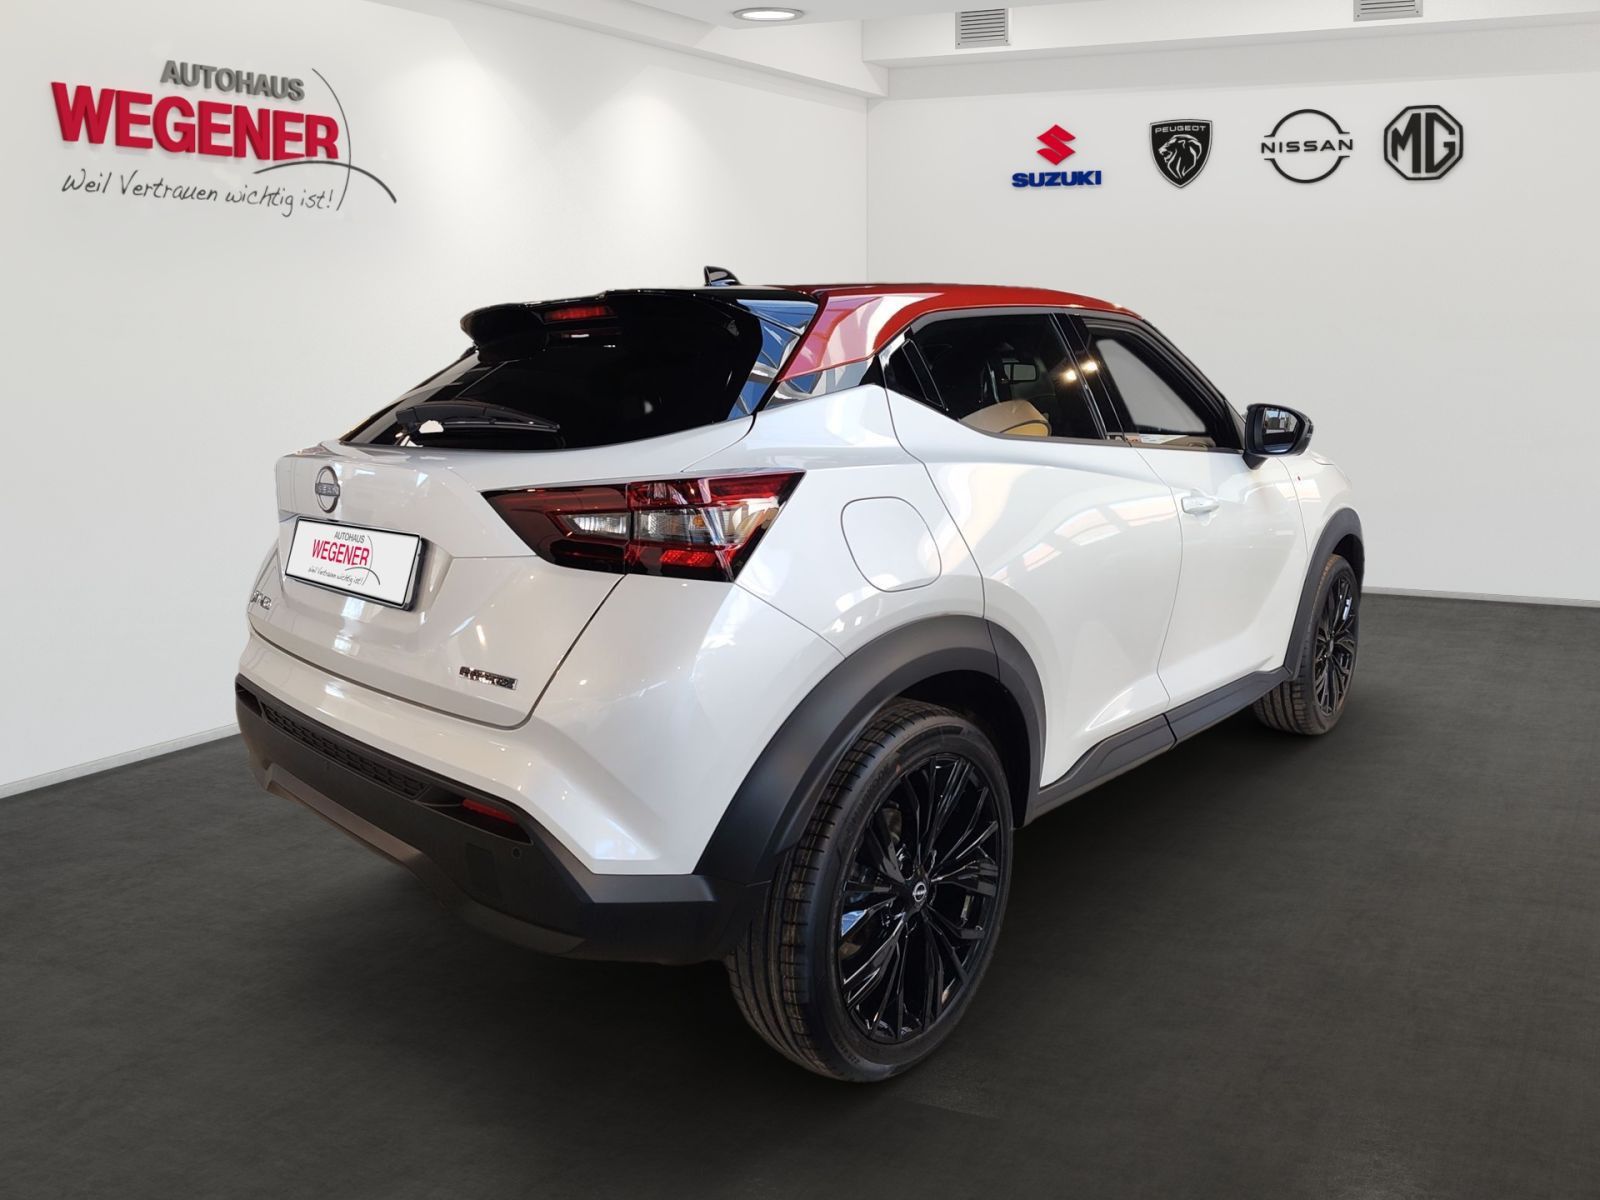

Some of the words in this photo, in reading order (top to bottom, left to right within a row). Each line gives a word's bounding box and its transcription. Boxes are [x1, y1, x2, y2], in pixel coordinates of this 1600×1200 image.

[160, 60, 305, 101] AUTOHAUS
[51, 81, 340, 161] WEGENER
[1154, 125, 1206, 134] PEUGEOT
[1261, 138, 1354, 154] NISSAN
[1391, 112, 1456, 174] MG
[1012, 170, 1102, 188] SUZUKI
[61, 168, 112, 194] Weil
[120, 170, 218, 202] Vertrauen
[225, 185, 294, 218] wichtig
[300, 190, 334, 210] ist!
[334, 531, 366, 544] AUTOHAUS
[312, 539, 370, 566] WEGENER
